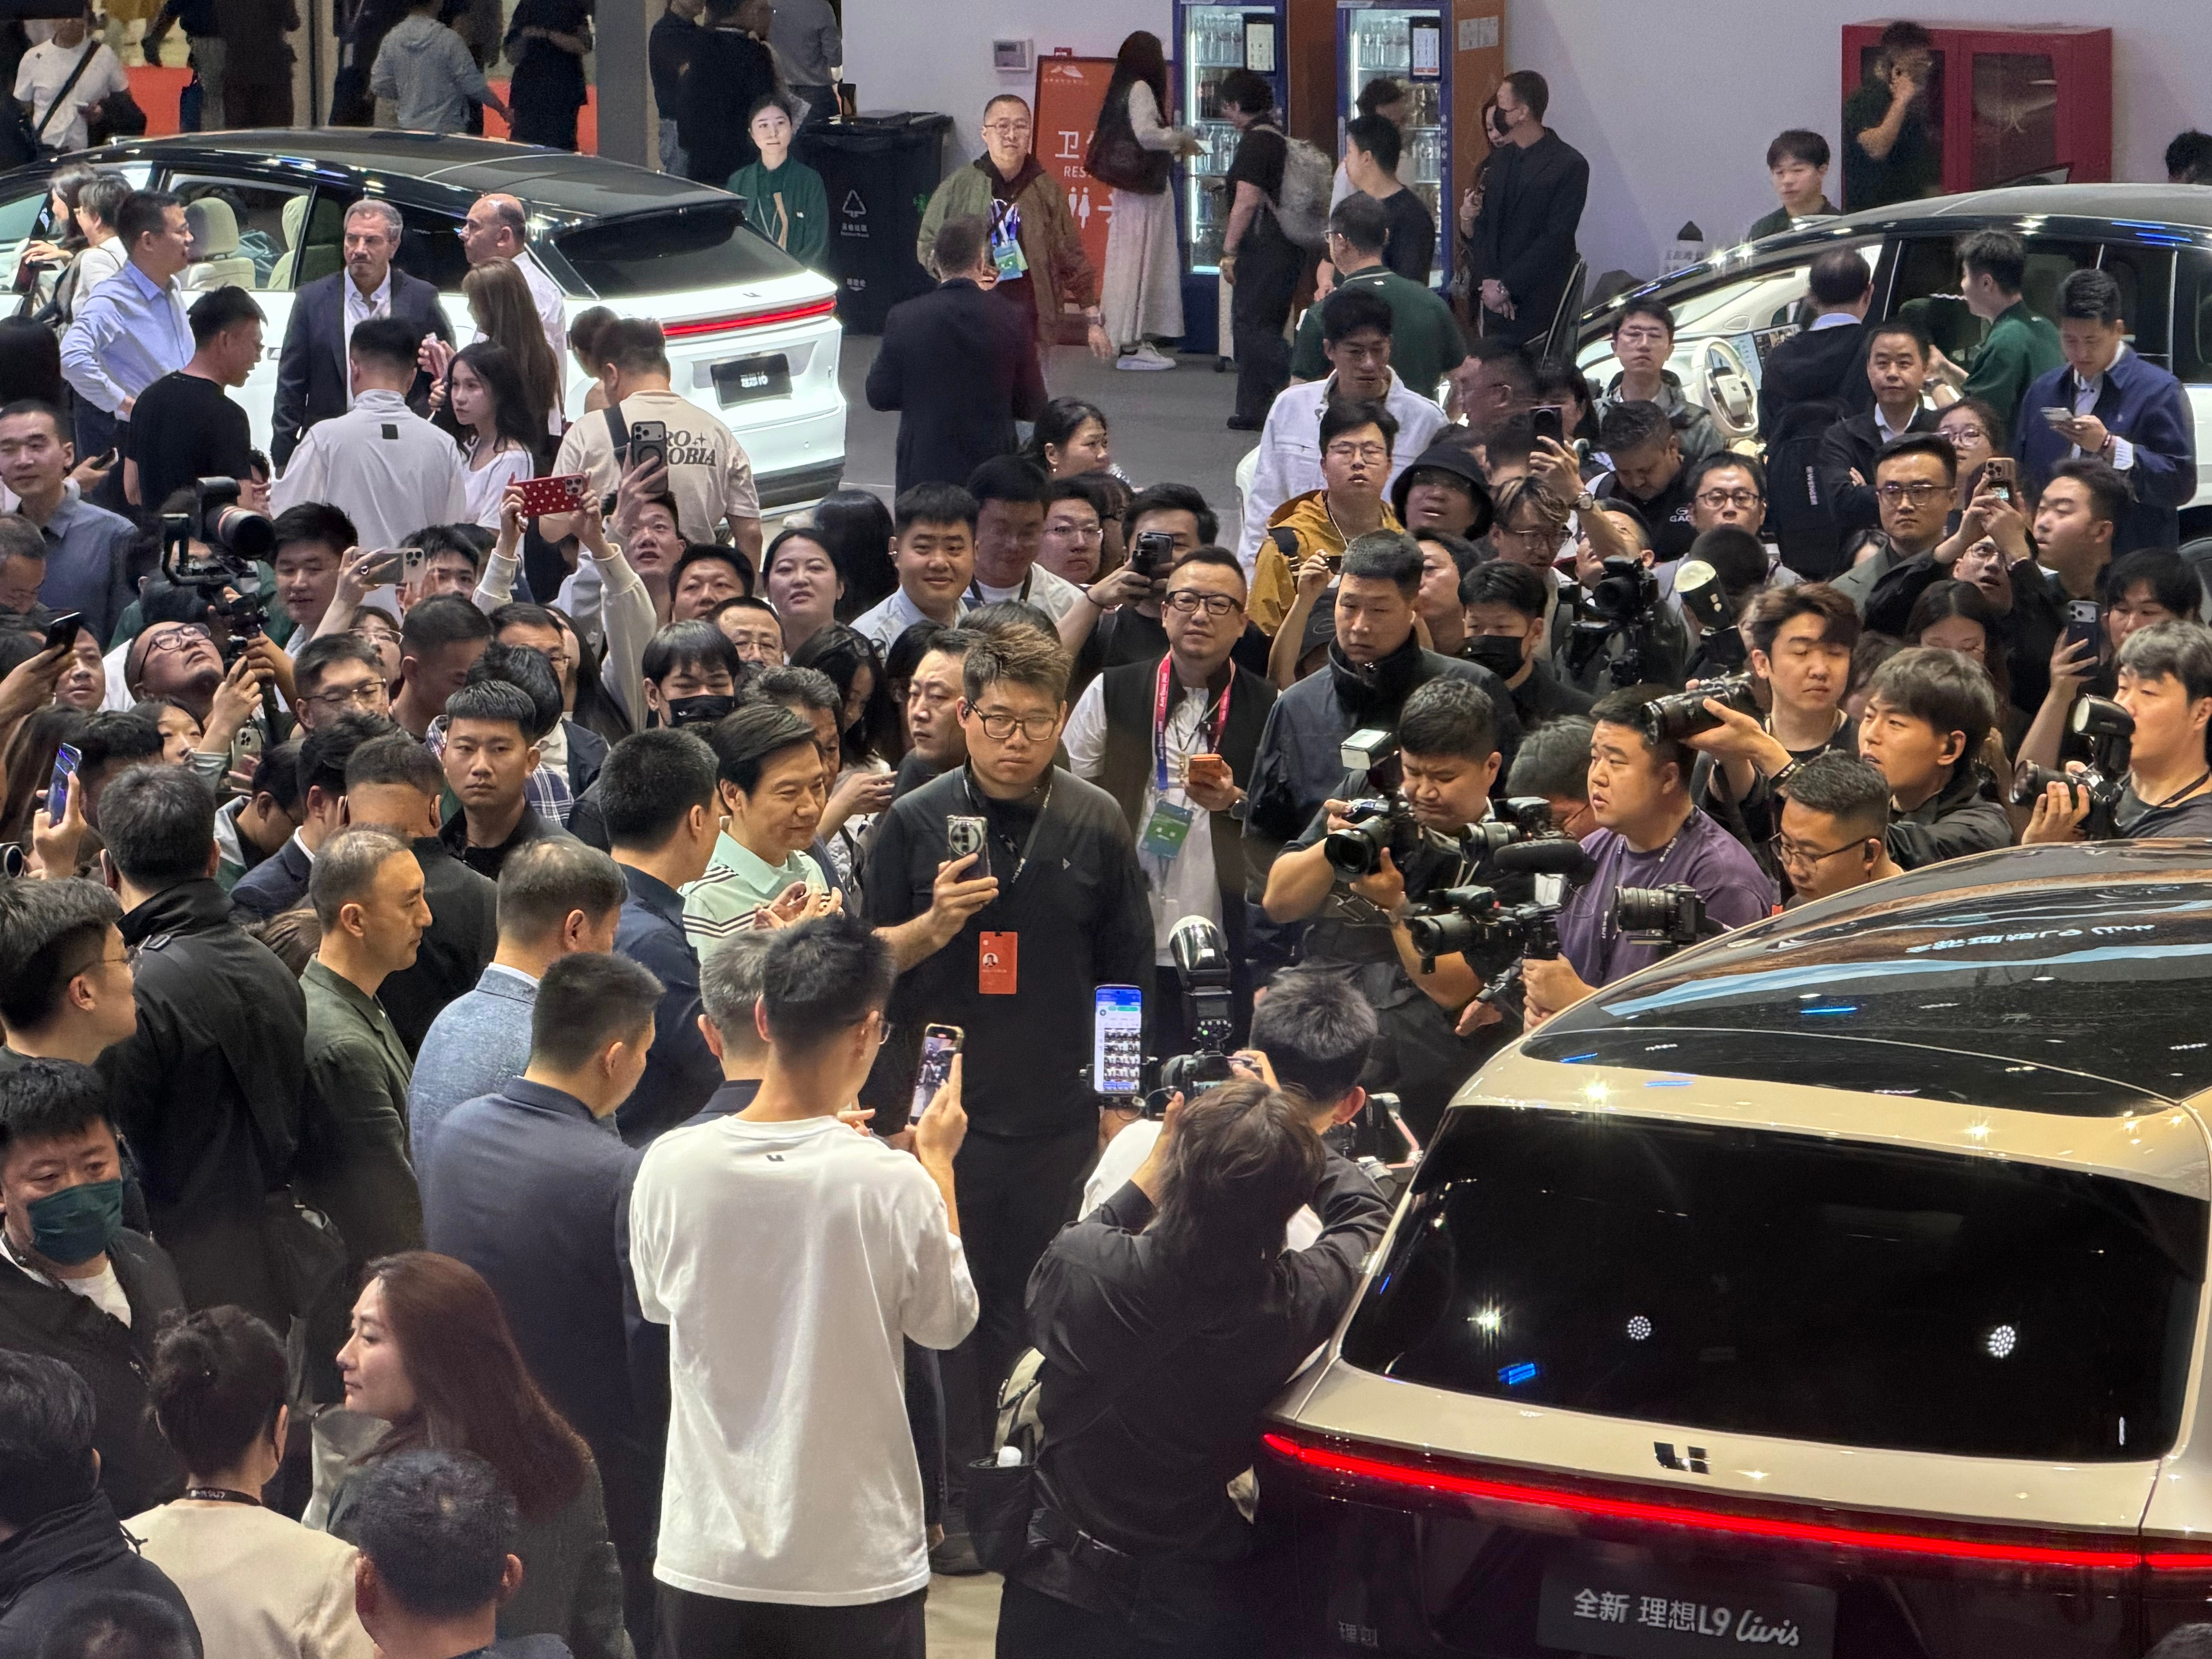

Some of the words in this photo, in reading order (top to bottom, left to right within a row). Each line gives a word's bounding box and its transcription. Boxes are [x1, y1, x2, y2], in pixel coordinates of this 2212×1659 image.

[1055, 131, 1095, 159] 卫
[1064, 166, 1092, 178] RES
[1574, 1588, 1630, 1623] 全新
[1638, 1596, 1731, 1636] 理想L9
